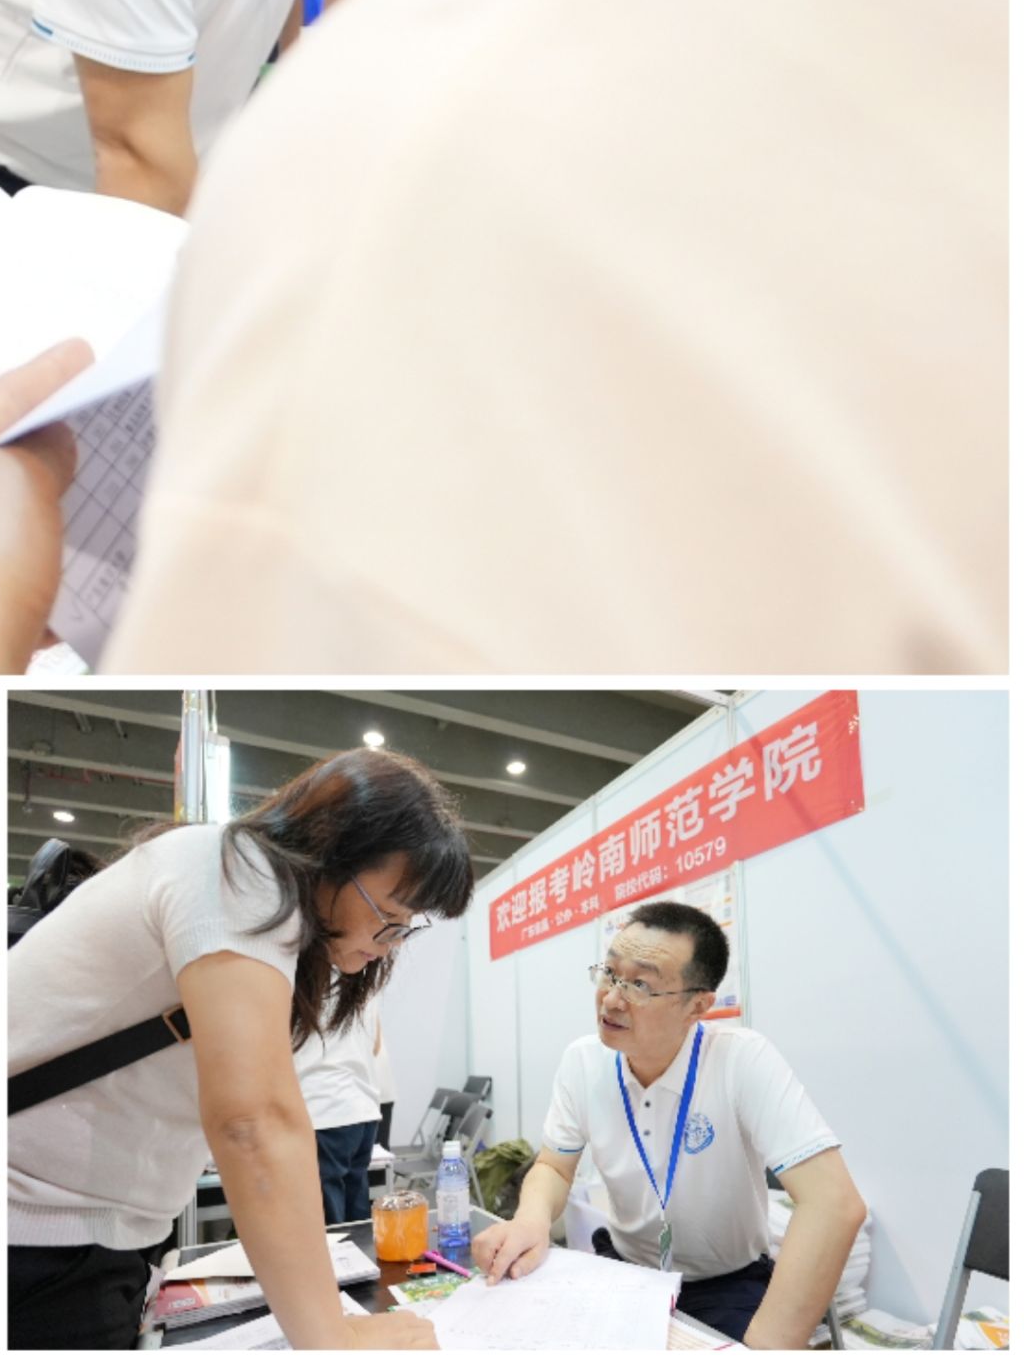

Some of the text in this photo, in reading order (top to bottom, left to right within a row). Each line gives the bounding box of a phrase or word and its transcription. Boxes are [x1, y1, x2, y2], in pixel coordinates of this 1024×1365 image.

[495, 721, 823, 933] 欢迎报考岭南师范学院
